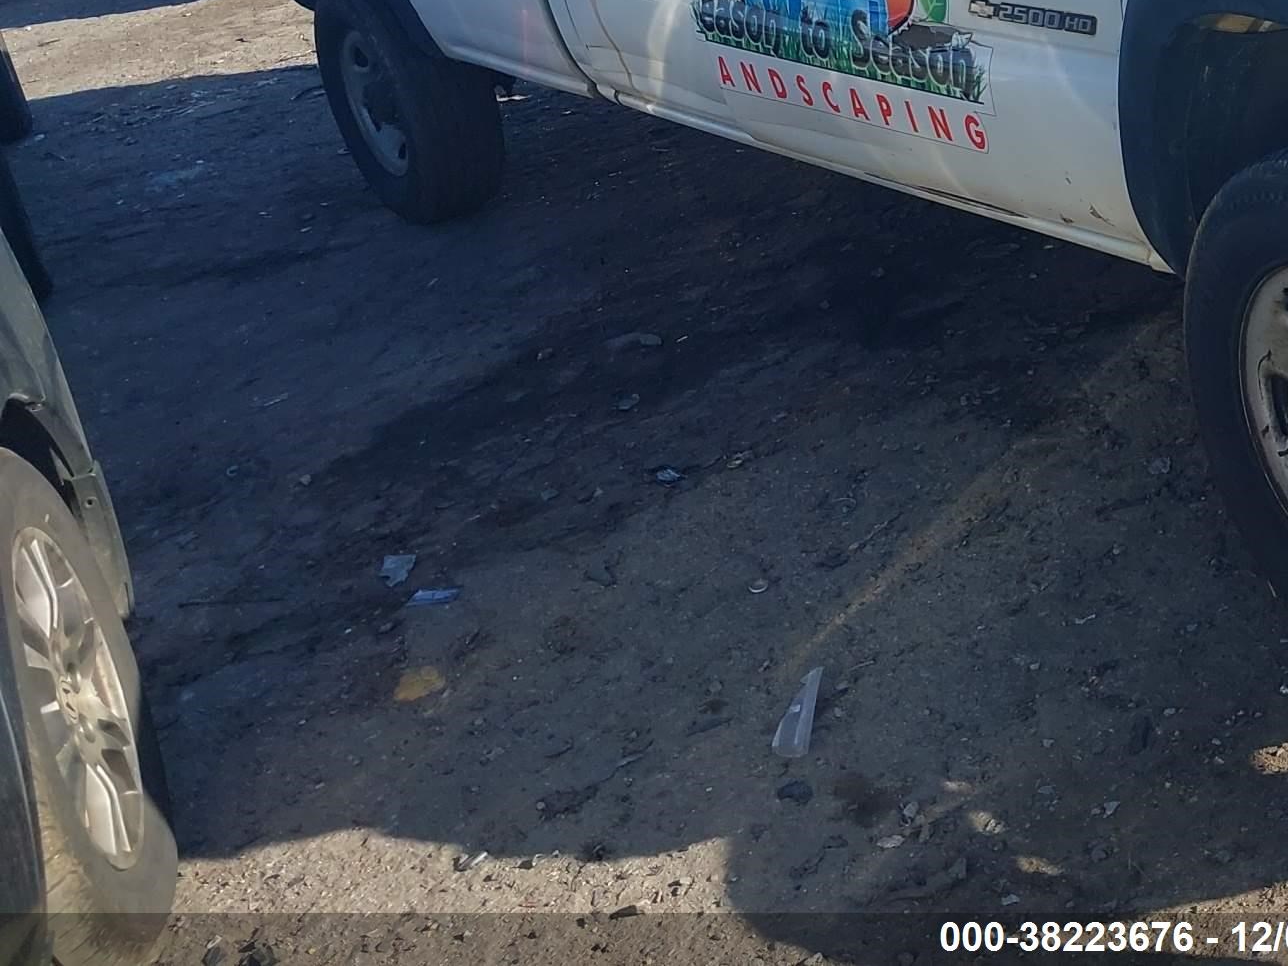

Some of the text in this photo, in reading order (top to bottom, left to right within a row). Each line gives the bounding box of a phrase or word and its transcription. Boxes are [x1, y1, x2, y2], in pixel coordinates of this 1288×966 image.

[799, 4, 832, 61] to
[850, 9, 978, 100] Season
[717, 56, 987, 151] ANDSCAPING
